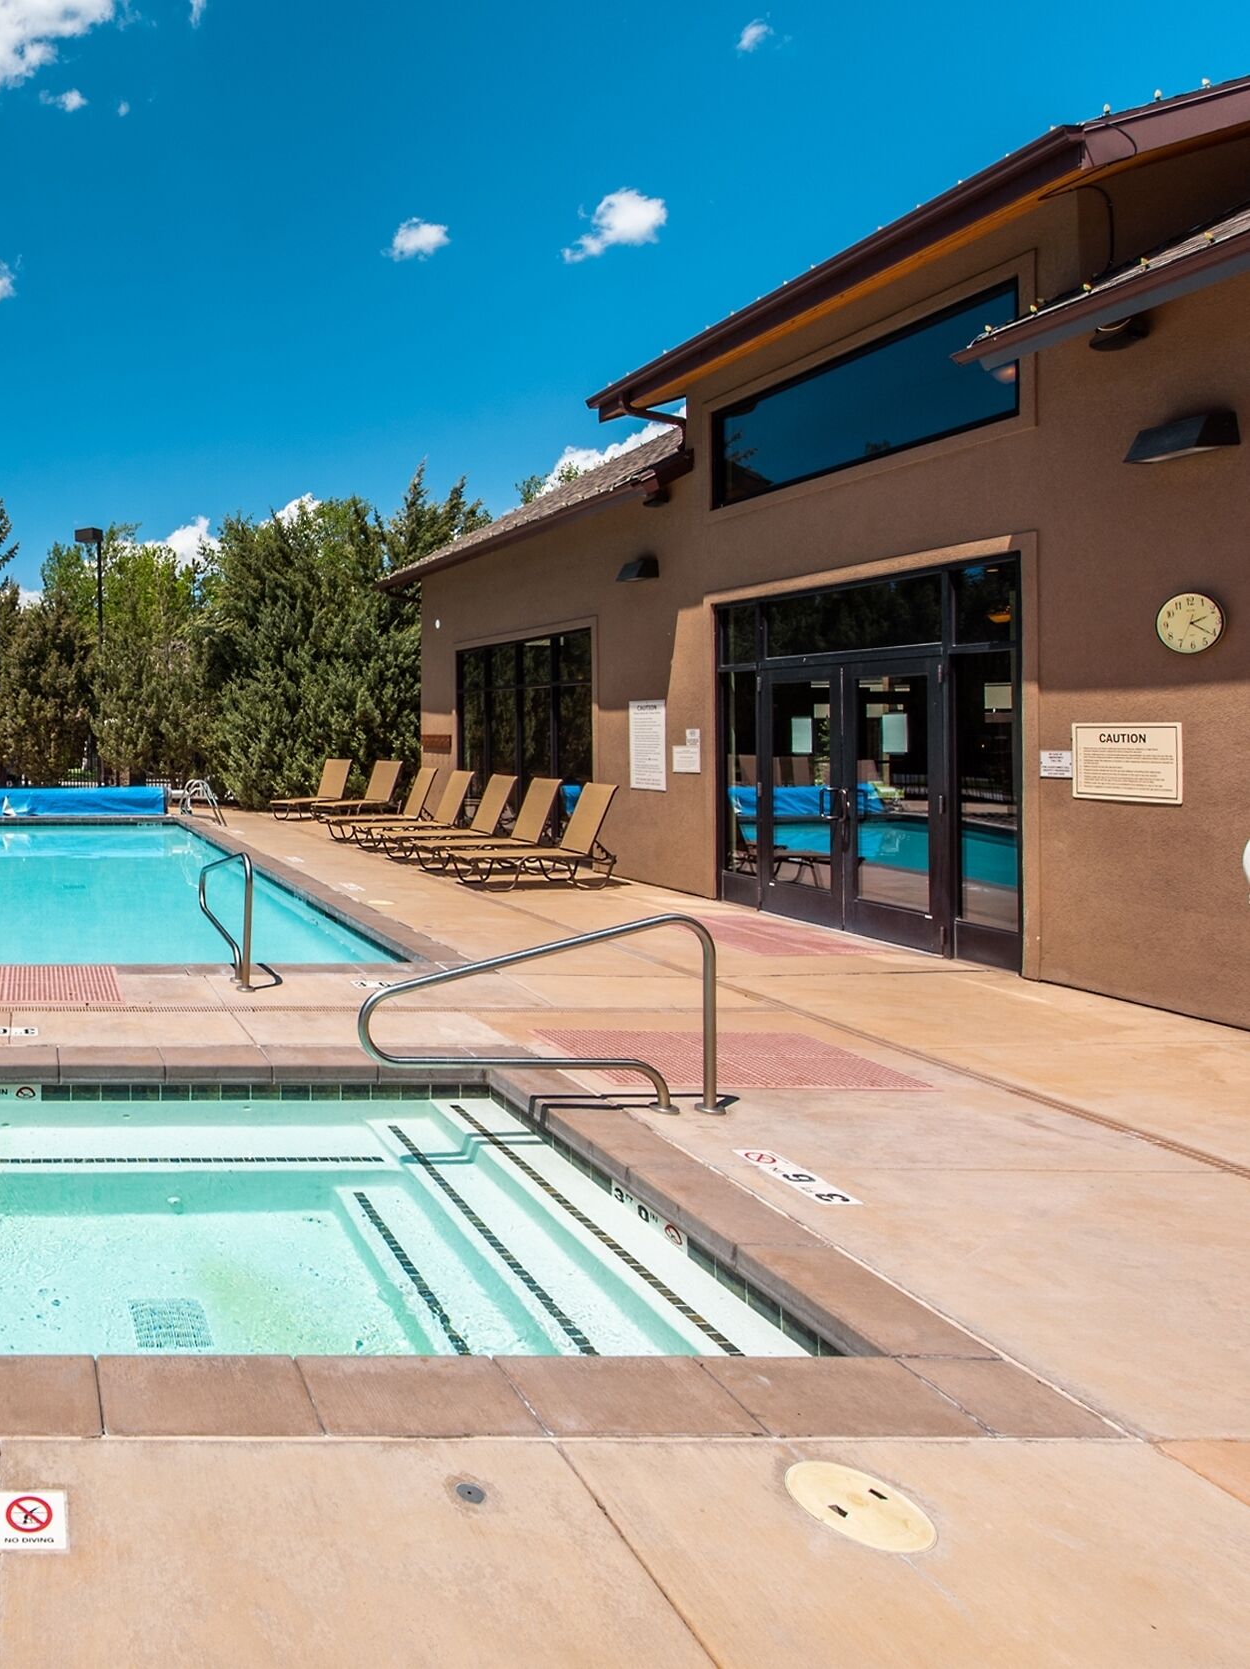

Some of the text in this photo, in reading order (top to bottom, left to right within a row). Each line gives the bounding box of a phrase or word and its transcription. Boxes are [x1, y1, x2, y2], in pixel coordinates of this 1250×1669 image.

[1175, 602, 1182, 610] 11
[1186, 597, 1194, 606] 12
[1210, 605, 1215, 614] 2
[1178, 639, 1183, 648] 7
[1190, 640, 1196, 649] 6
[1203, 637, 1209, 646] 5
[1099, 733, 1147, 744] CAUTION
[614, 1187, 624, 1204] 3
[637, 1205, 650, 1223] 0
